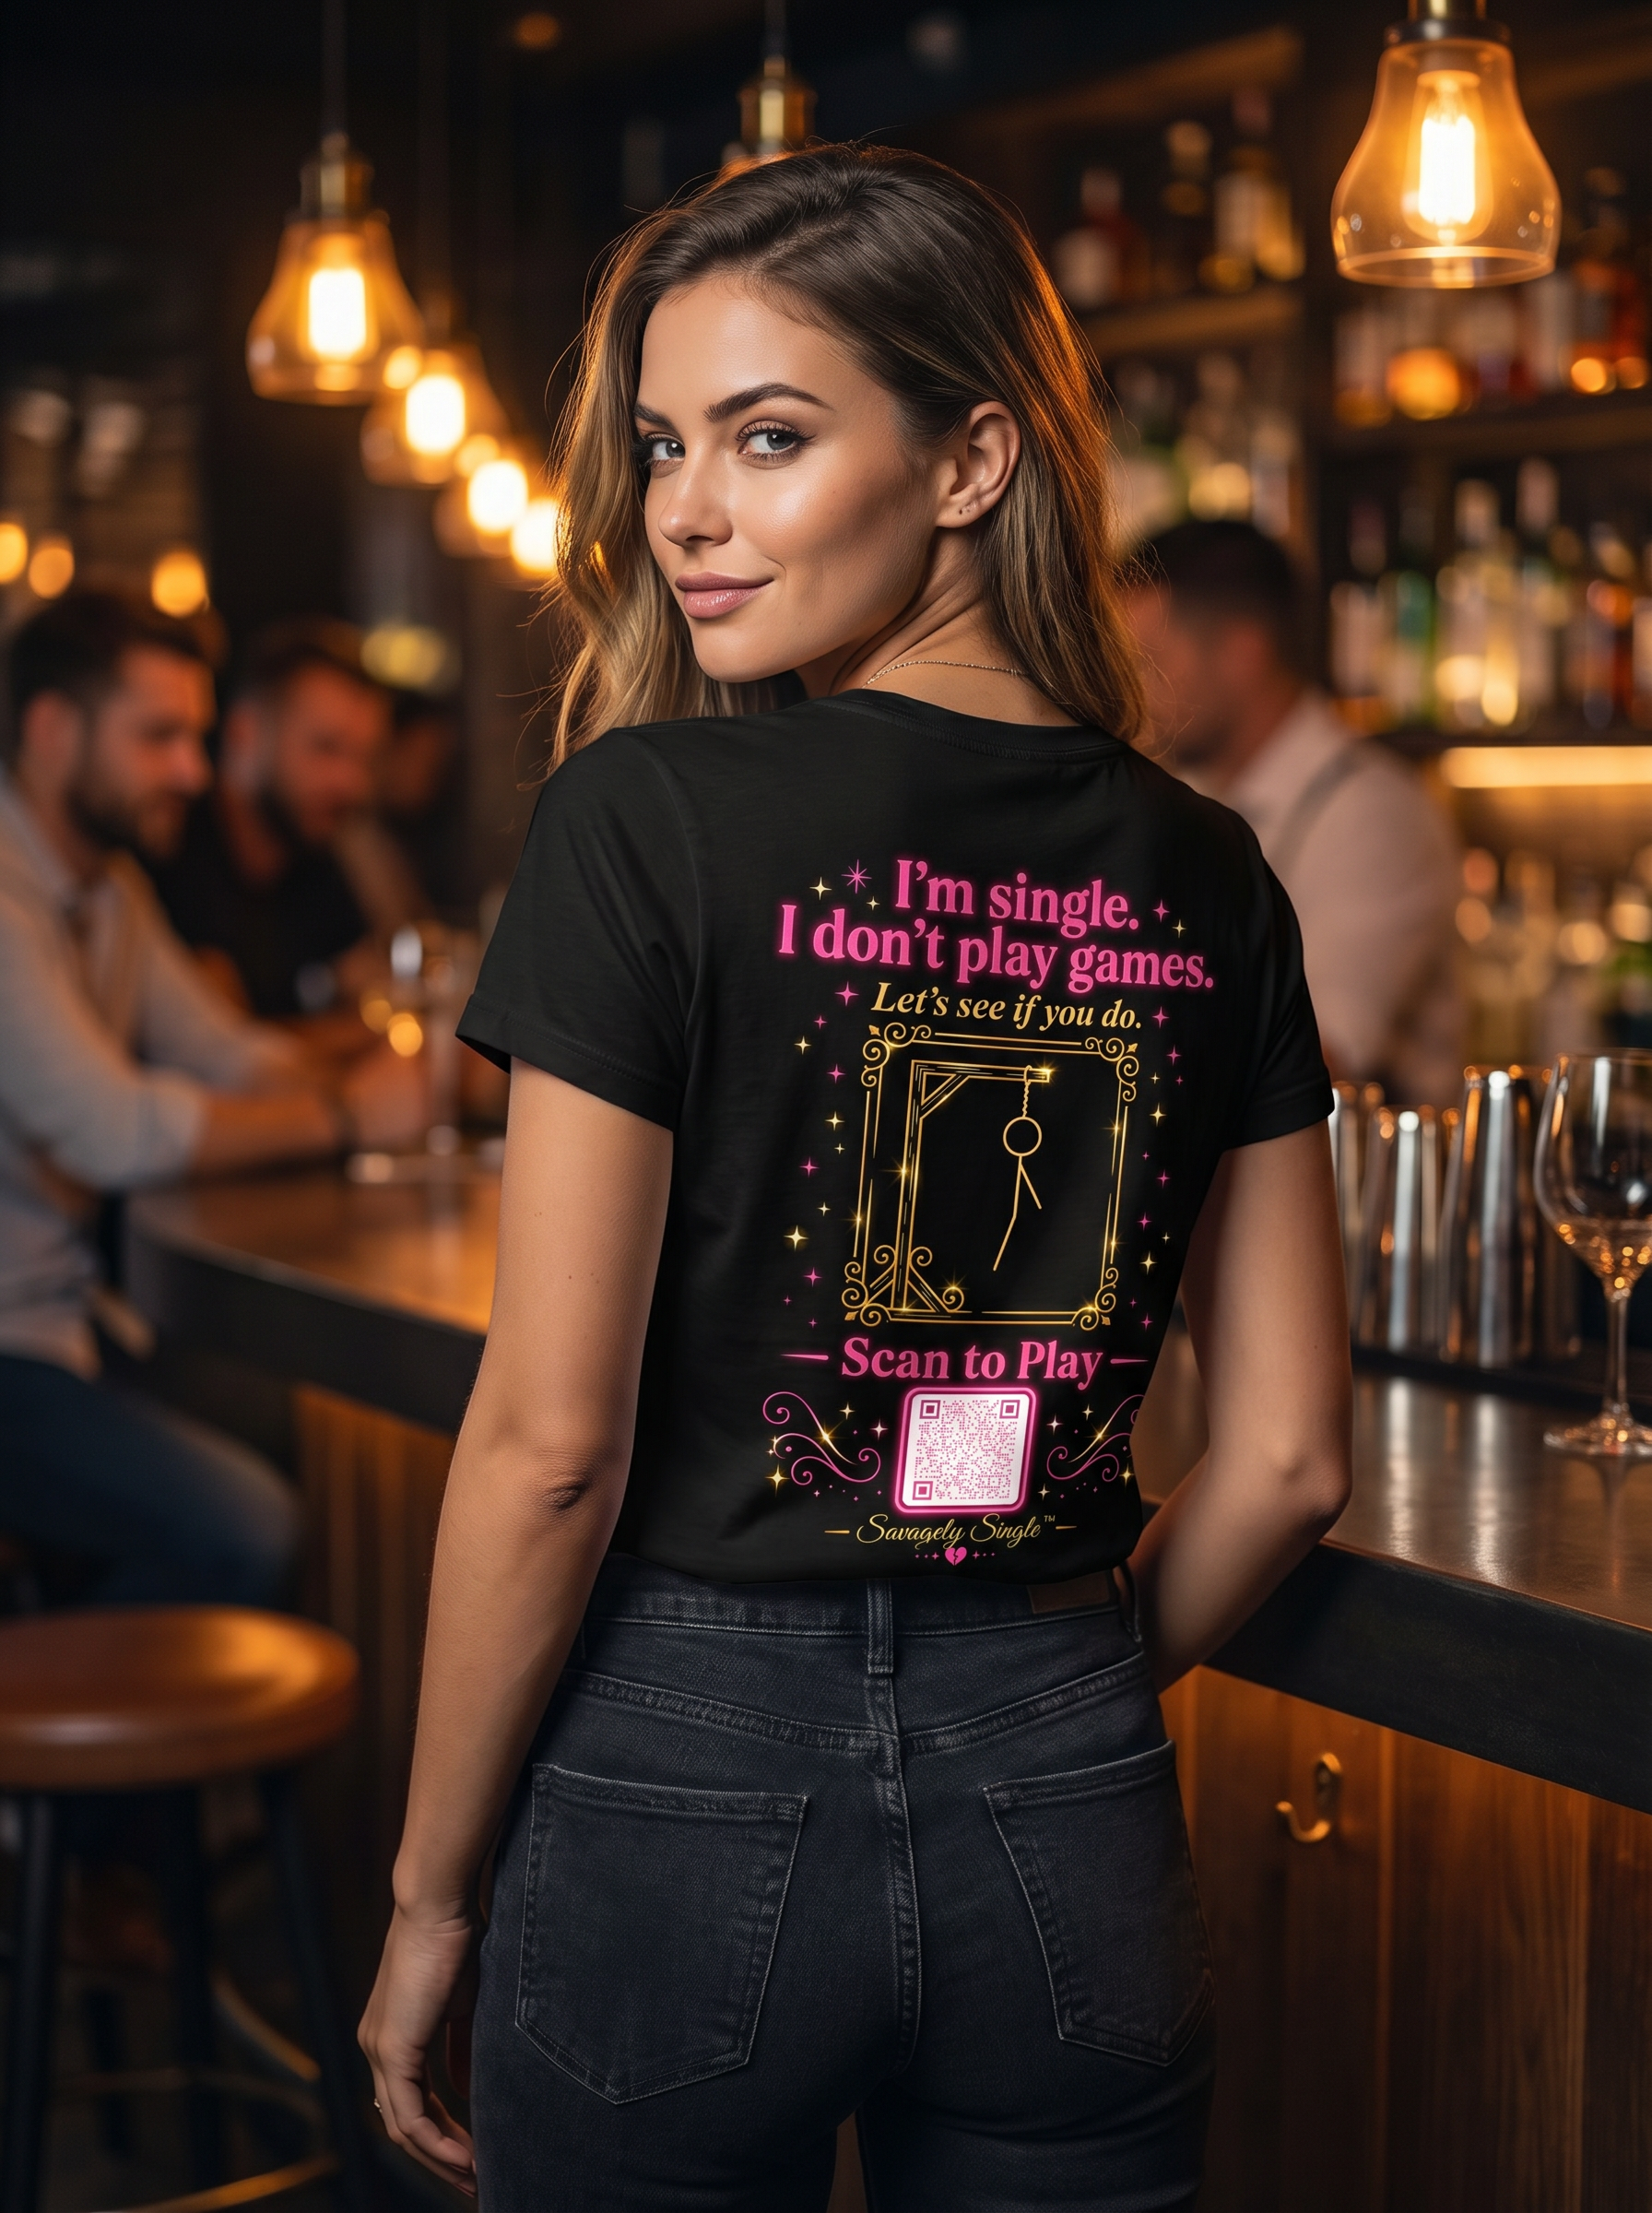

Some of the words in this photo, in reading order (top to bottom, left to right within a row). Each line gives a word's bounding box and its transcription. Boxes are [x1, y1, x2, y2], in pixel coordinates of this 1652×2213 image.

[894, 858, 974, 915] I’m
[989, 872, 1139, 939] single.
[778, 904, 798, 954] I
[813, 907, 945, 969] don’t
[957, 925, 1057, 989] play
[1068, 942, 1215, 994] games.
[956, 995, 1006, 1021] see
[1012, 993, 1041, 1031] if
[1039, 1006, 1094, 1031] you
[1101, 999, 1142, 1029] do.
[841, 1337, 950, 1379] Scan
[964, 1343, 1006, 1379] to
[1016, 1339, 1103, 1391] Play
[856, 1513, 966, 1550] Savagely
